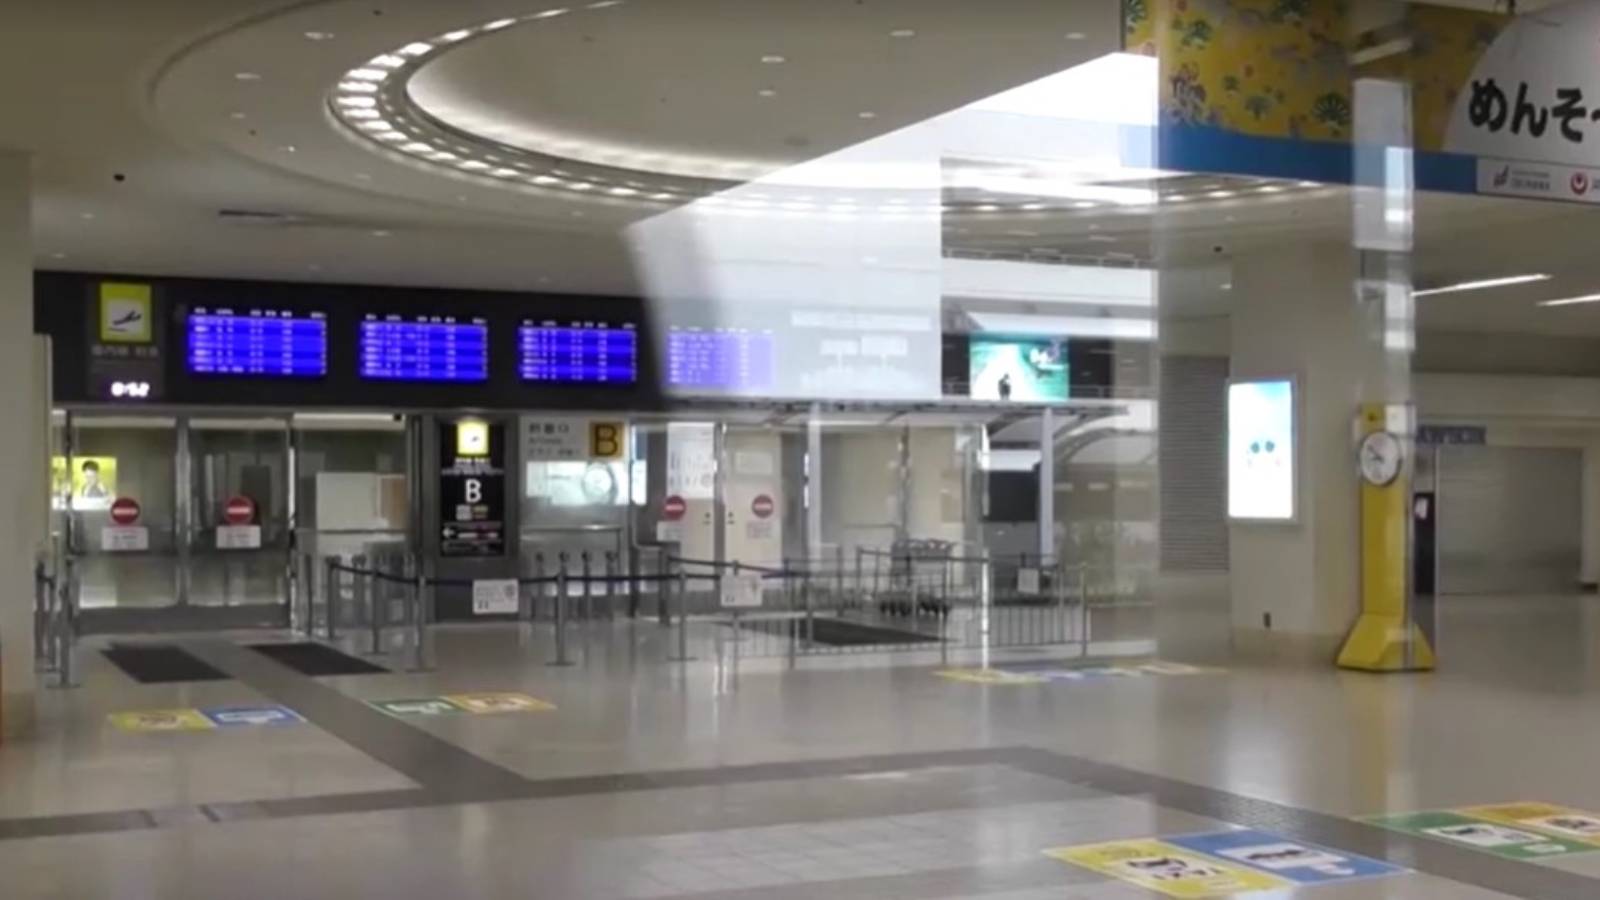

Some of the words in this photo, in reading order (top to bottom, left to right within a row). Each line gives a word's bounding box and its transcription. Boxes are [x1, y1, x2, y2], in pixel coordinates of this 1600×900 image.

[1469, 77, 1600, 143] めんそ
[594, 424, 618, 456] B
[465, 478, 482, 503] B
